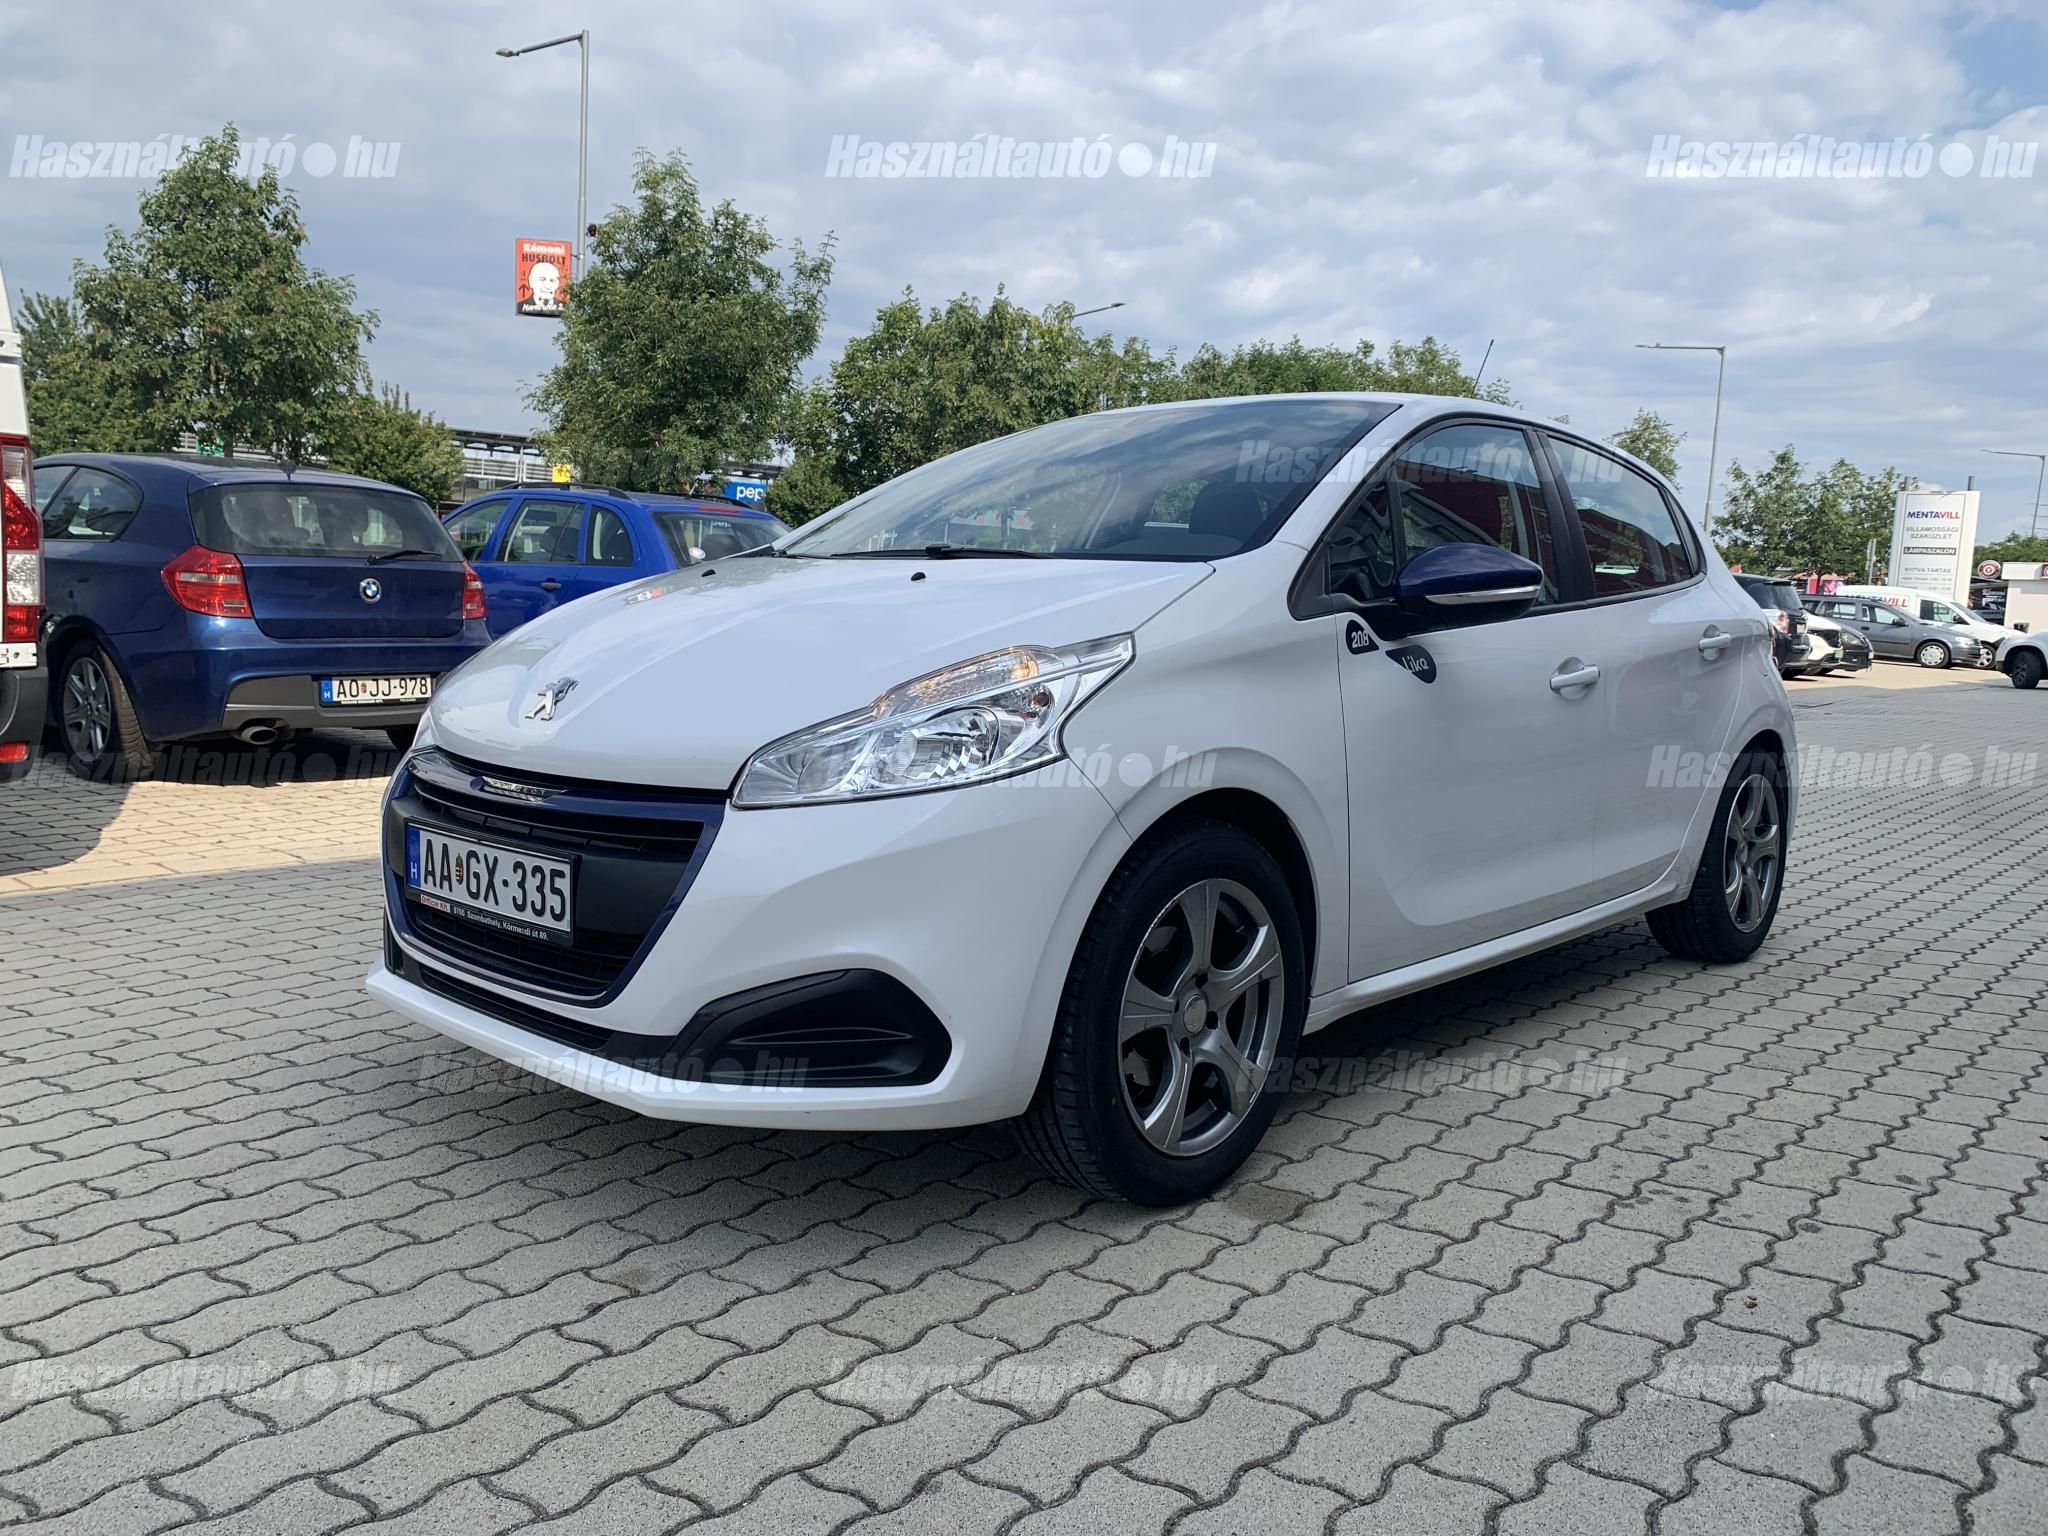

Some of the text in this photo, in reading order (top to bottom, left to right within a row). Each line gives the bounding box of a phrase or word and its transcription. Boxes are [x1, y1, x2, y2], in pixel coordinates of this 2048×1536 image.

[1906, 511, 1961, 520] MENTAVILL
[1351, 630, 1370, 648] 208
[323, 690, 331, 698] H
[410, 862, 418, 880] H
